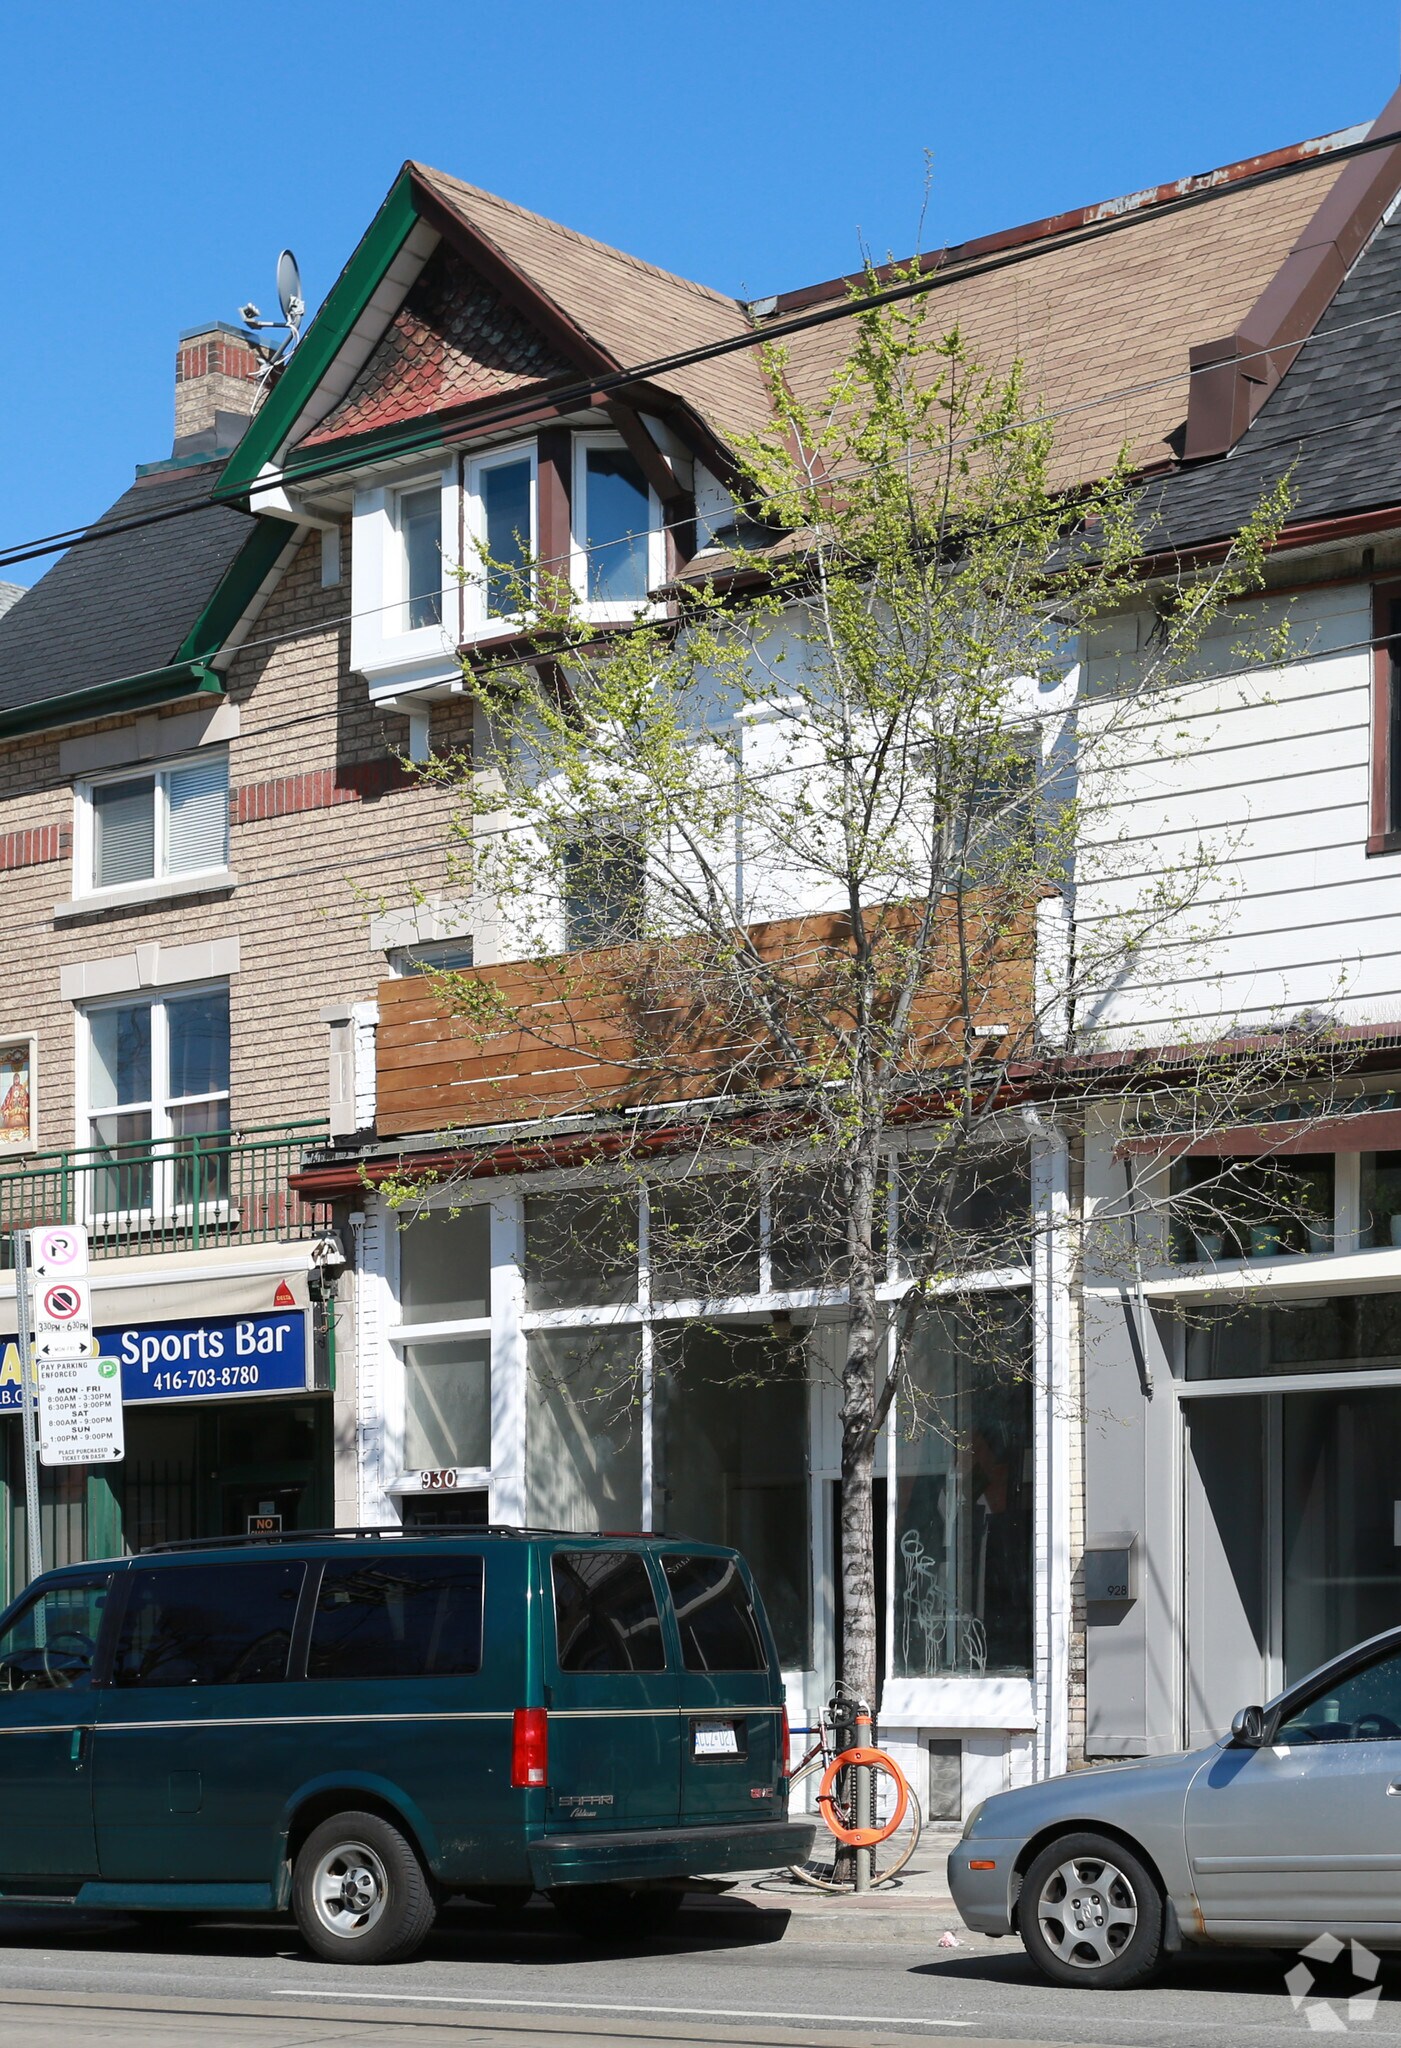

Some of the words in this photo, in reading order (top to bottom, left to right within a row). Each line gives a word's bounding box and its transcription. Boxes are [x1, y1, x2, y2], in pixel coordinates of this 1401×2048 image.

[121, 1325, 224, 1374] Sports
[235, 1320, 291, 1356] Bar
[41, 1363, 55, 1371] PAY
[57, 1362, 88, 1370] PARKING
[41, 1370, 77, 1379] ENFORCED
[153, 1365, 259, 1391] 416-703-8780
[47, 1395, 77, 1403] 8:00AM
[83, 1393, 112, 1401] 3:30PM
[48, 1403, 77, 1411] 6:30PM
[83, 1401, 112, 1409] 9:00PM
[48, 1419, 78, 1427] 8:00AM
[84, 1416, 113, 1424] 9:00PM
[84, 1432, 113, 1440] 9:00PM
[422, 1469, 456, 1489] 930
[256, 1518, 273, 1529] NO
[1107, 1585, 1127, 1596] 928
[558, 1794, 614, 1806] SAFARI
